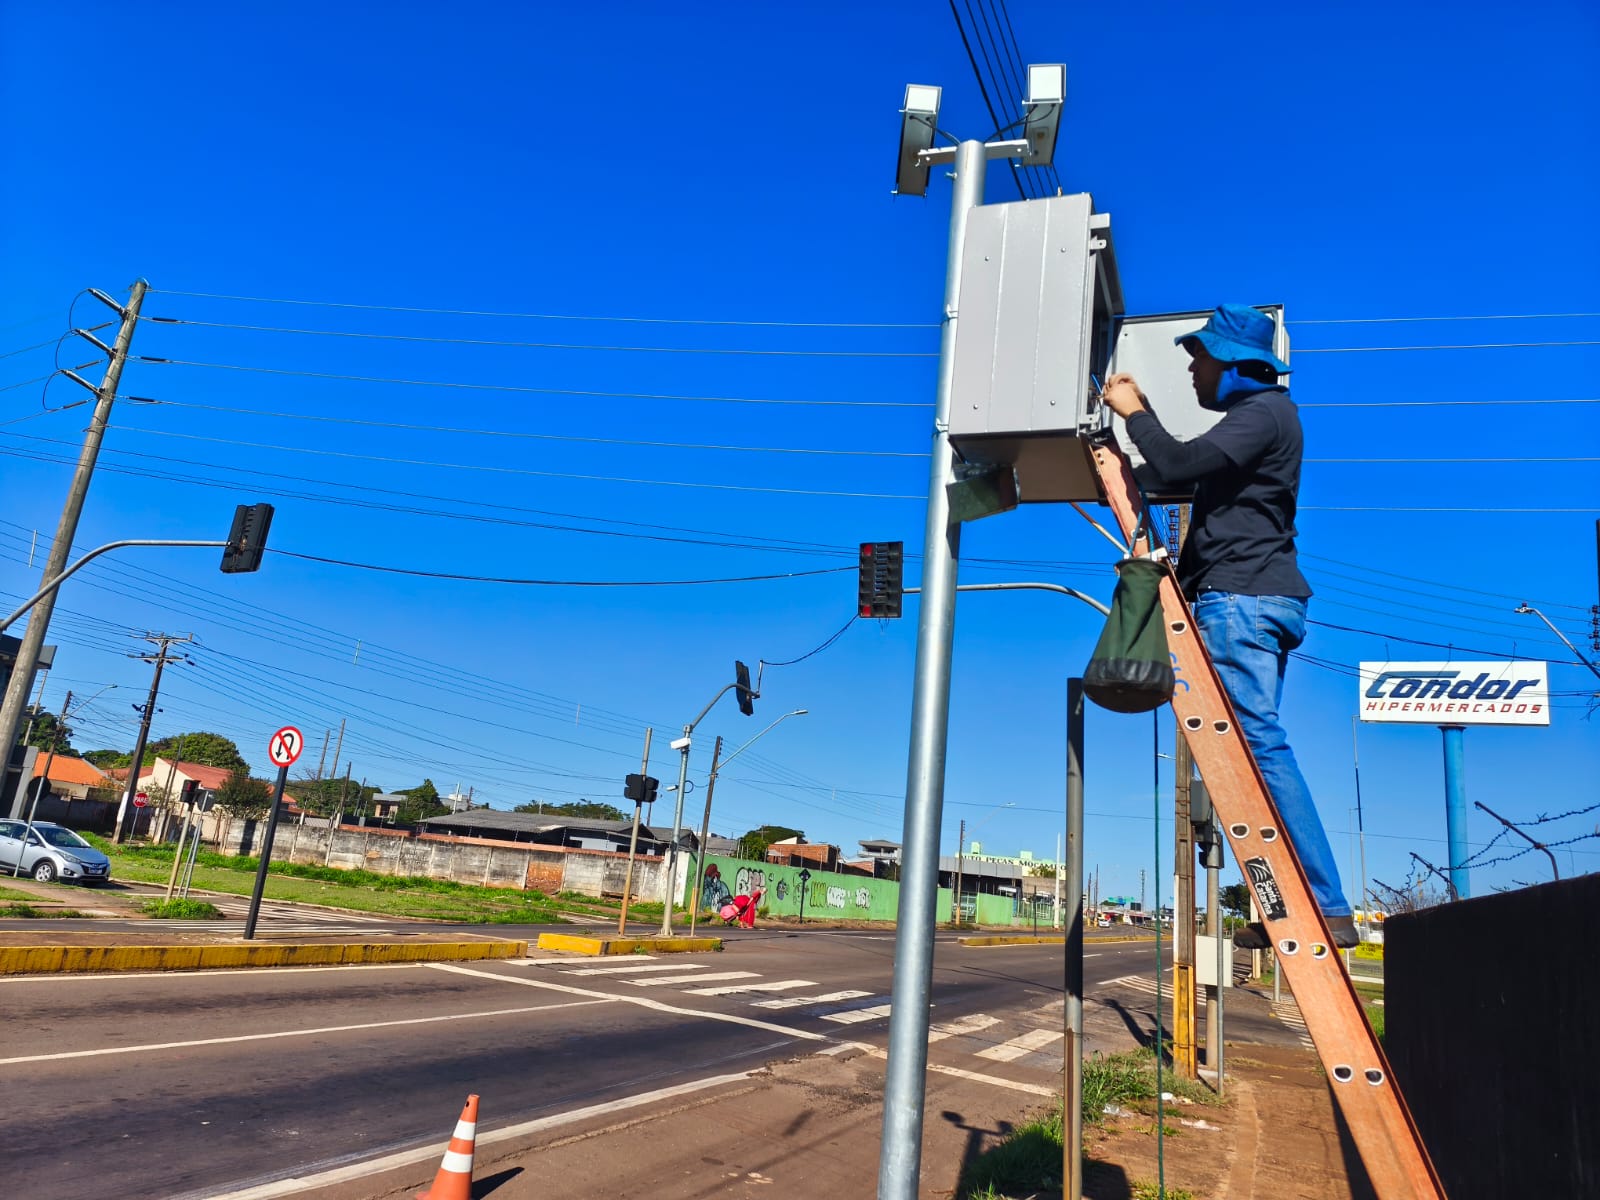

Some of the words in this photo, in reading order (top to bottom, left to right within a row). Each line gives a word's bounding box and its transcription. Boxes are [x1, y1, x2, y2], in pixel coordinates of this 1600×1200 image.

[1365, 671, 1540, 700] Condor
[1365, 702, 1542, 714] HIPERMERCADOS
[1255, 882, 1273, 915] Catarina
[1265, 880, 1278, 904] Santa
